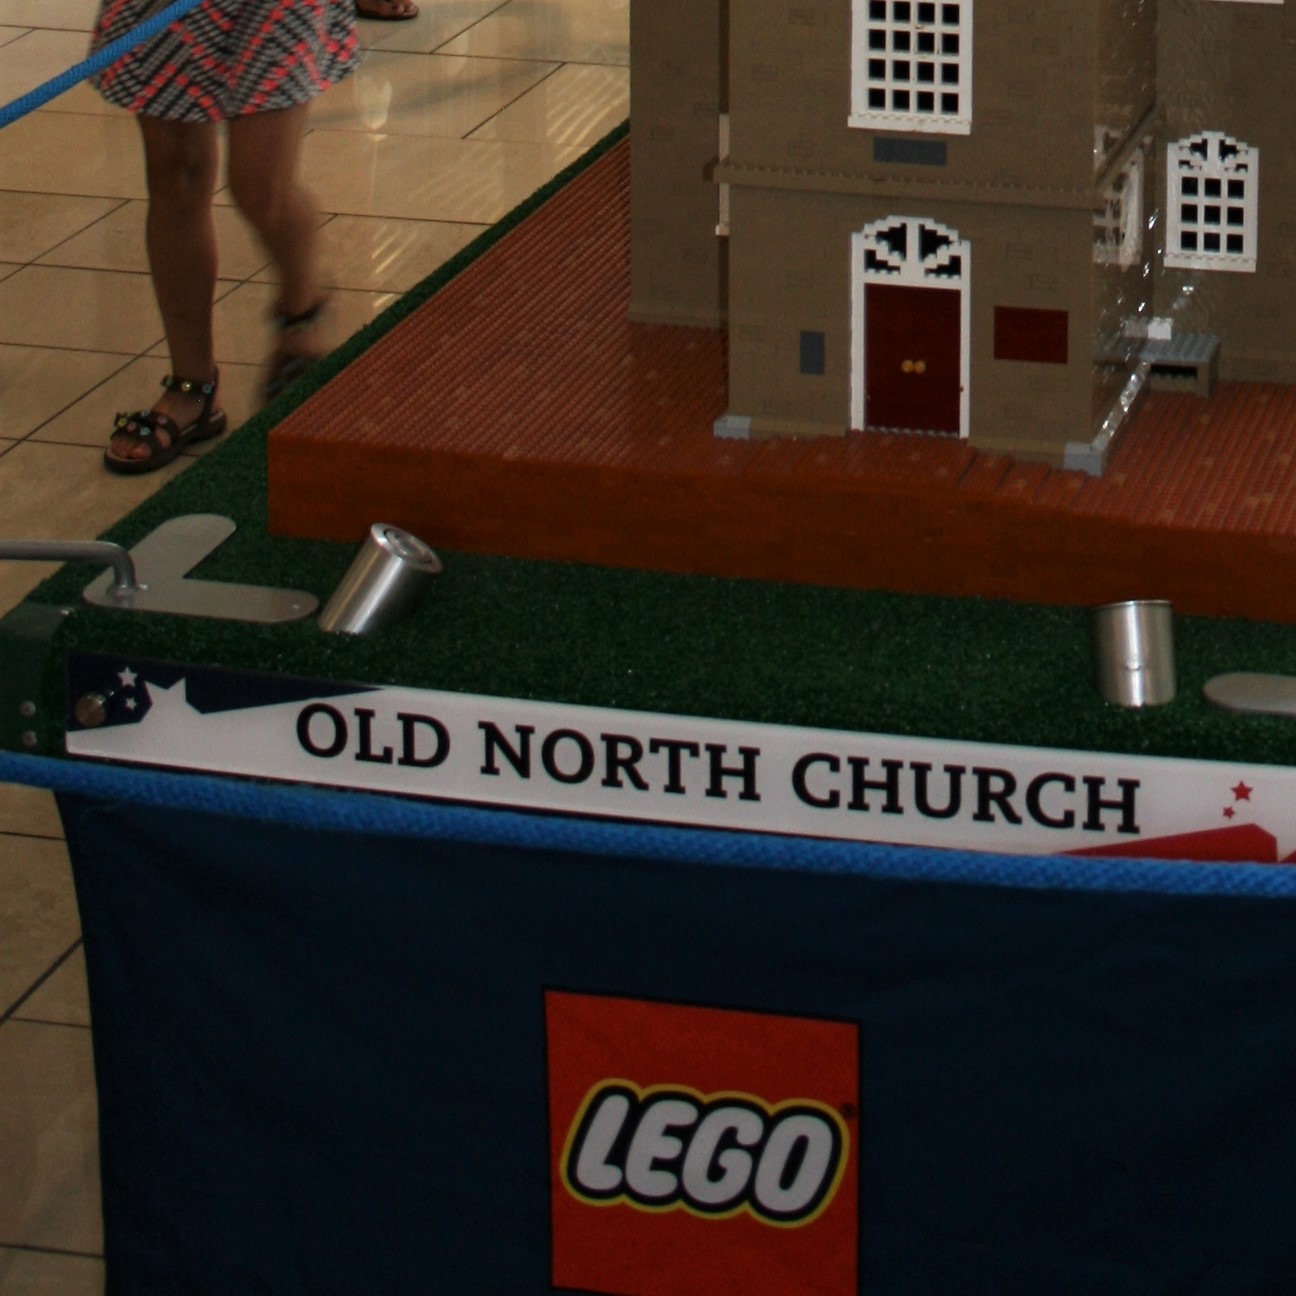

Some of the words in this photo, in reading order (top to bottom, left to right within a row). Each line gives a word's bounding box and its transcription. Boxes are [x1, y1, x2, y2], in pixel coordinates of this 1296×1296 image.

[295, 701, 451, 769] OLD
[478, 720, 762, 802] NORTH
[791, 752, 1142, 836] CHURCH
[566, 1083, 844, 1222] LEGO
